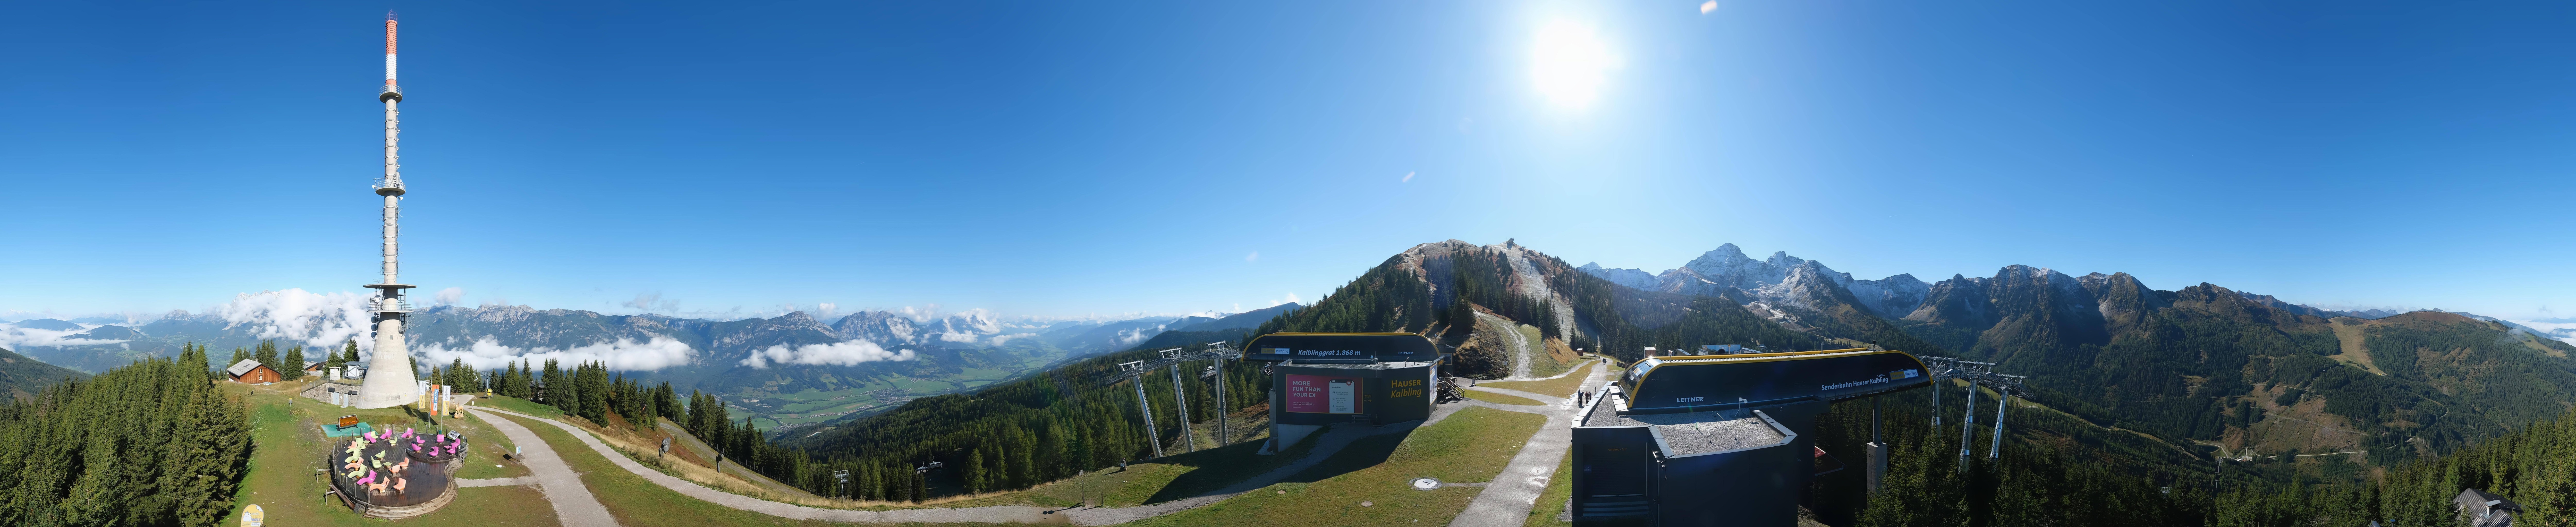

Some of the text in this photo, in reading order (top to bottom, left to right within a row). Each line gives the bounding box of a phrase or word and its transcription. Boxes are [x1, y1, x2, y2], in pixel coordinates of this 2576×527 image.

[1392, 379, 1421, 388] HAUSER
[1822, 381, 1852, 390] Senderbahn
[1391, 388, 1422, 398] Kaibling
